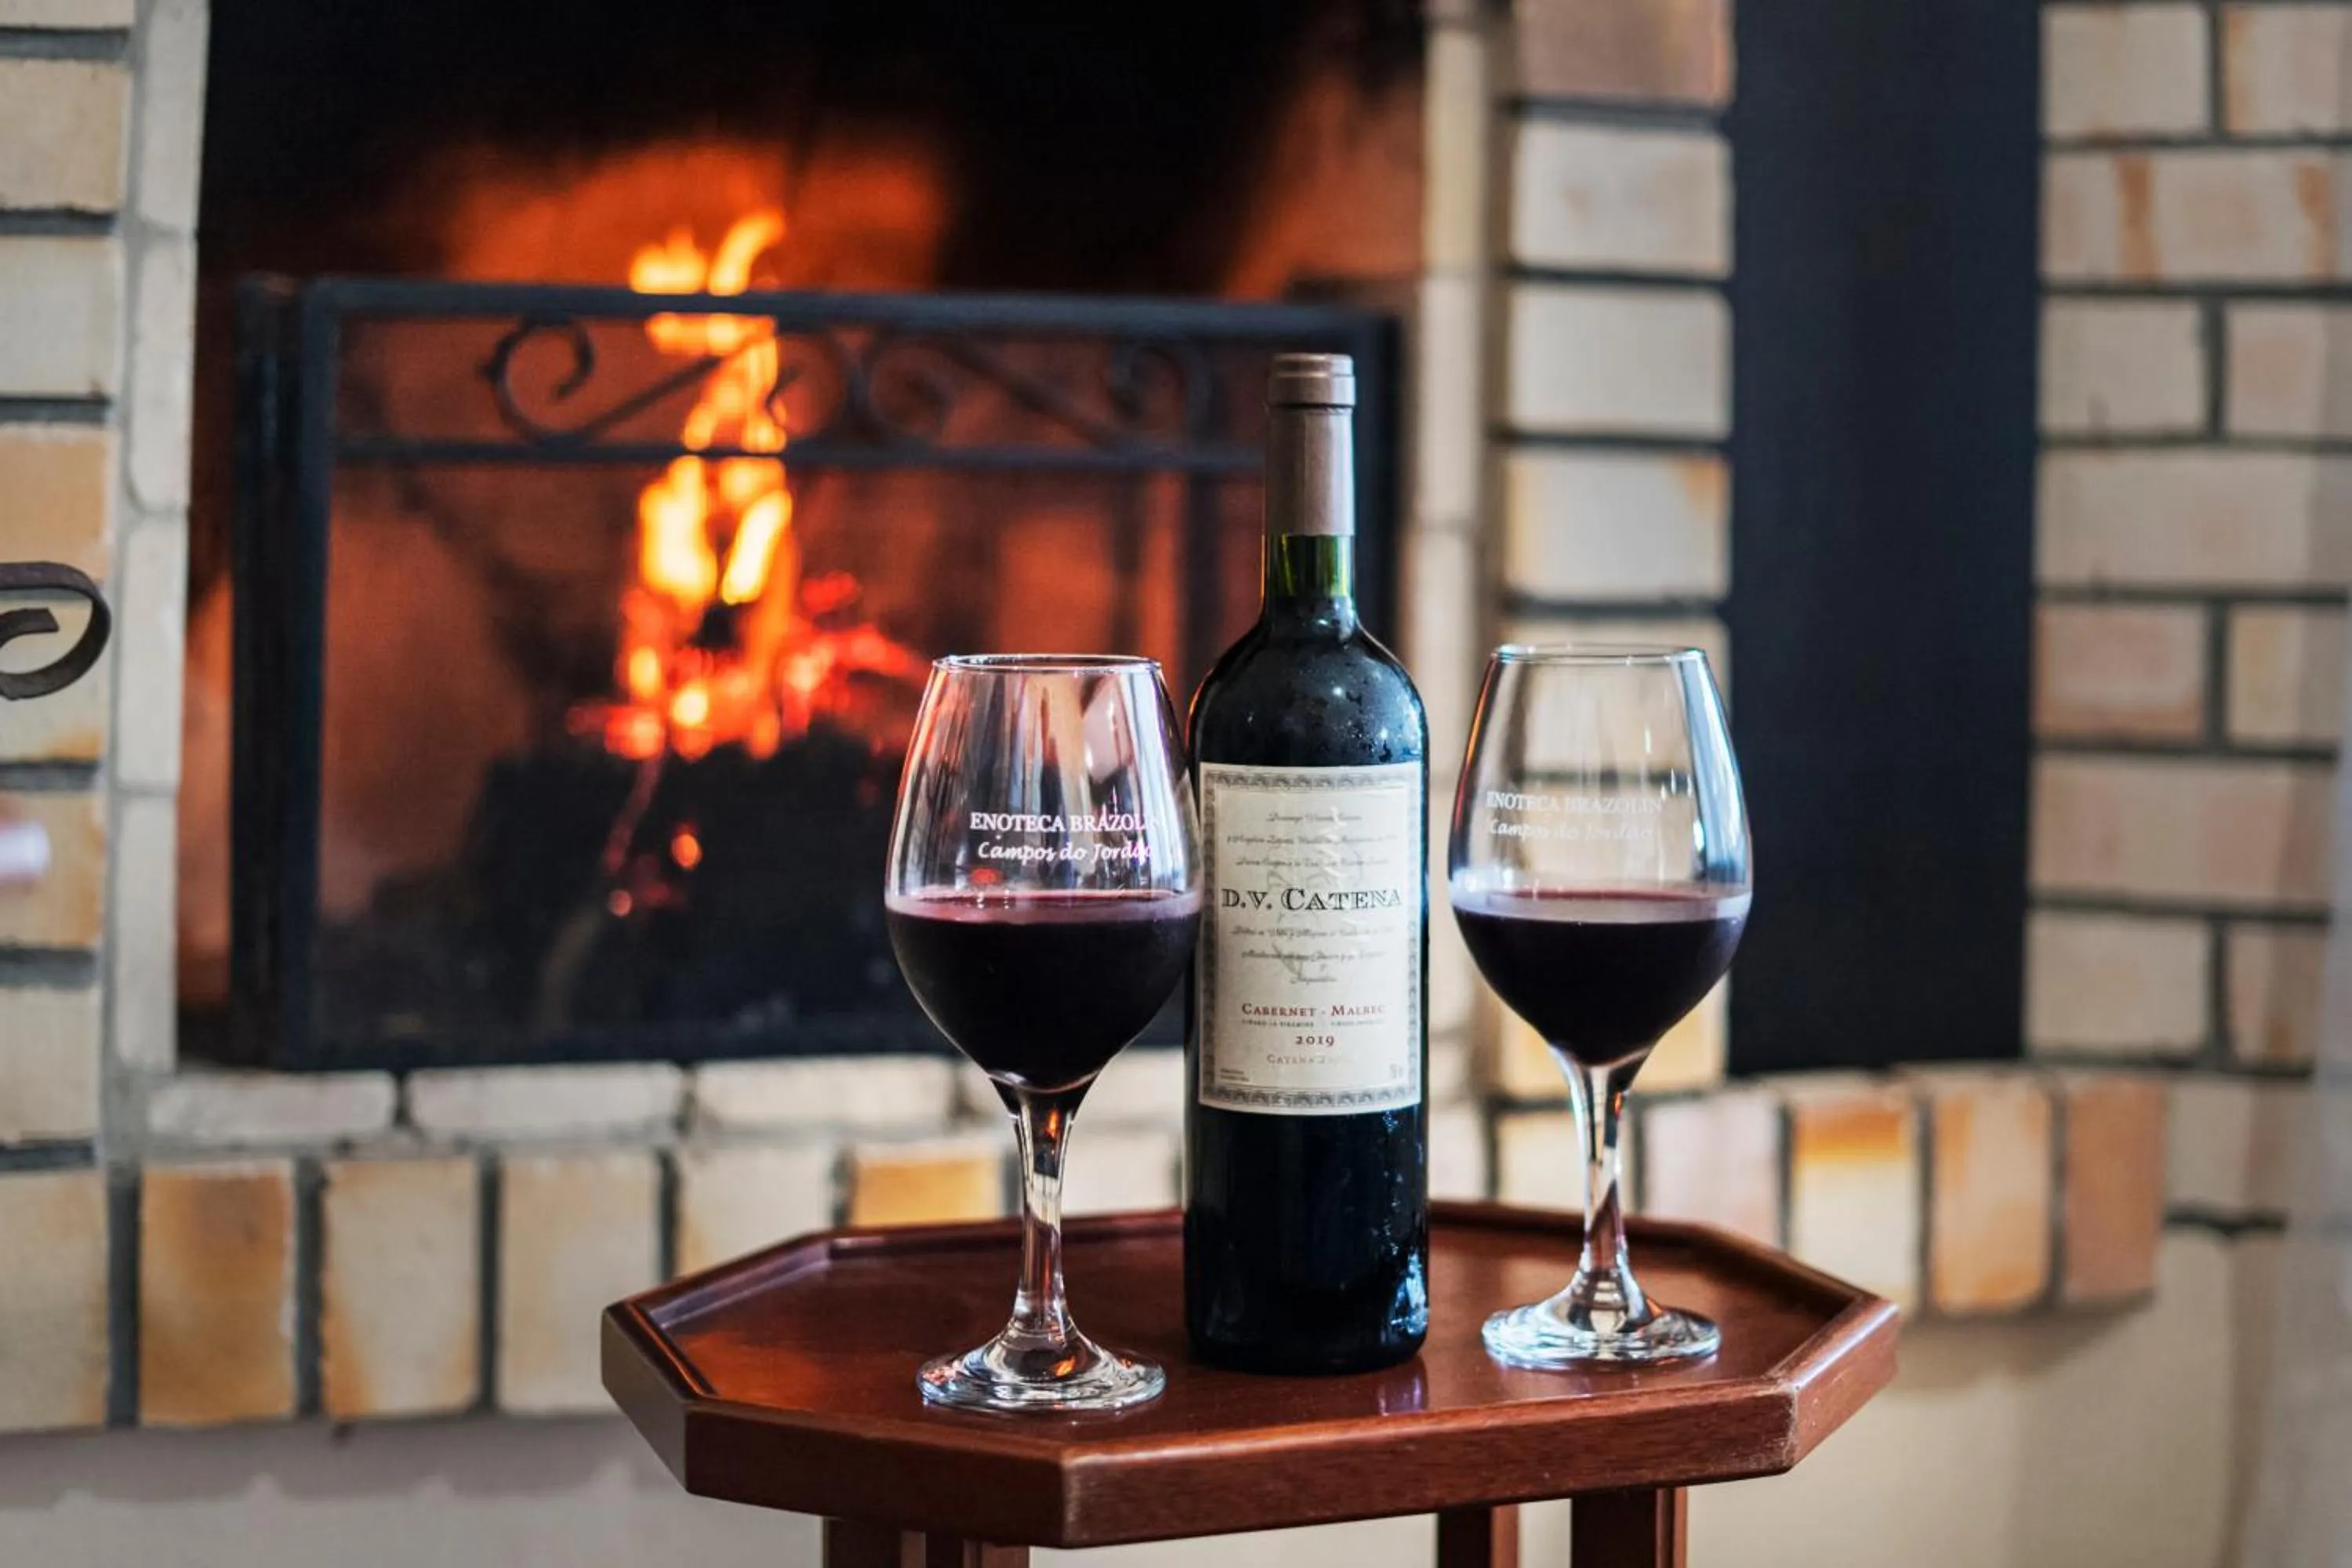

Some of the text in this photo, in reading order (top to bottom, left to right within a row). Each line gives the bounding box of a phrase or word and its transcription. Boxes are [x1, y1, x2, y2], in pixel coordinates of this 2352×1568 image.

[1486, 791, 1561, 811] ENOTECA
[970, 812, 1158, 833] ENOTECA BRAZOL
[978, 841, 1056, 866] Campos
[1060, 842, 1087, 861] do
[1222, 887, 1402, 910] D.V. CATENA
[1242, 1003, 1316, 1017] CABERNET
[1331, 1004, 1386, 1017] MALBEC
[1295, 1035, 1334, 1047] 2019
